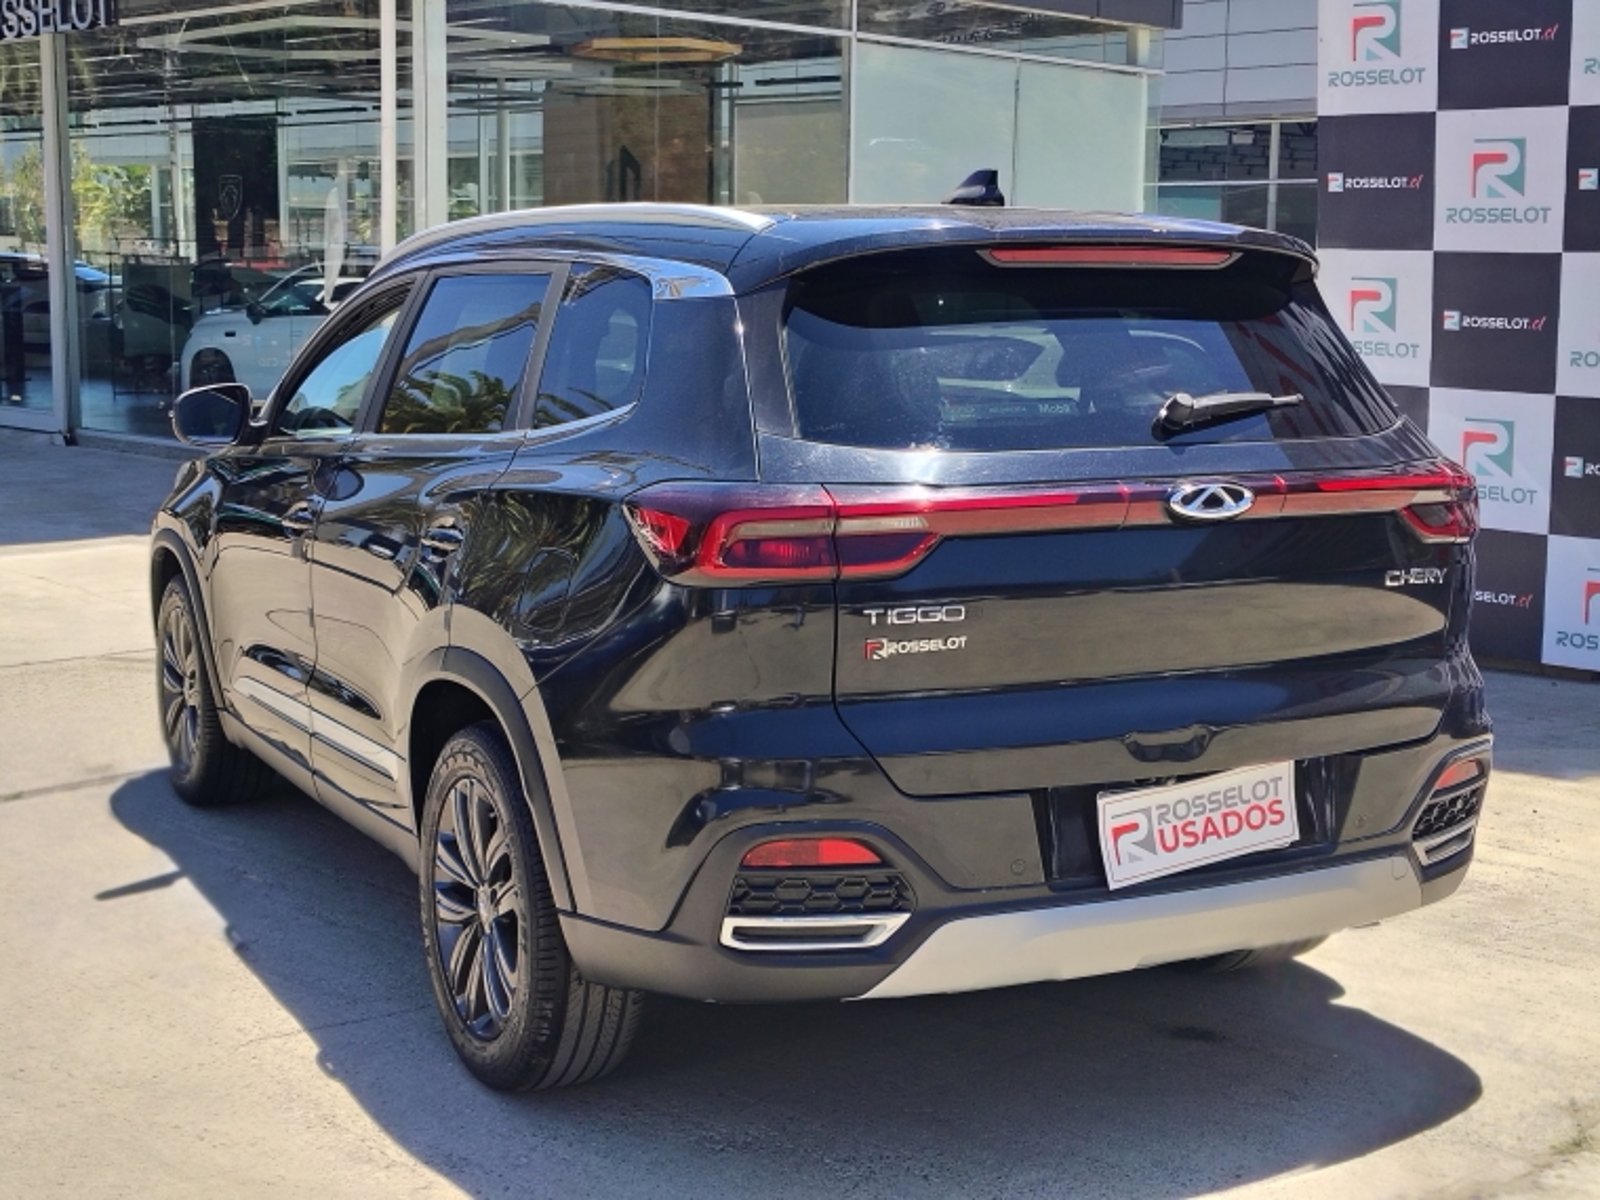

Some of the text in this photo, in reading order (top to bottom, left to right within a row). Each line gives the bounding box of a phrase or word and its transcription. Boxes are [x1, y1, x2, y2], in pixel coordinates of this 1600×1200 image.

[1328, 67, 1426, 87] ROSSELOT
[1446, 206, 1552, 224] ROSSELOT
[1385, 567, 1448, 587] CHERY
[863, 605, 965, 625] TIGGO
[887, 635, 967, 656] ROSSELOT
[1155, 776, 1283, 826] ROSSELOT
[1157, 799, 1285, 853] USADOS
